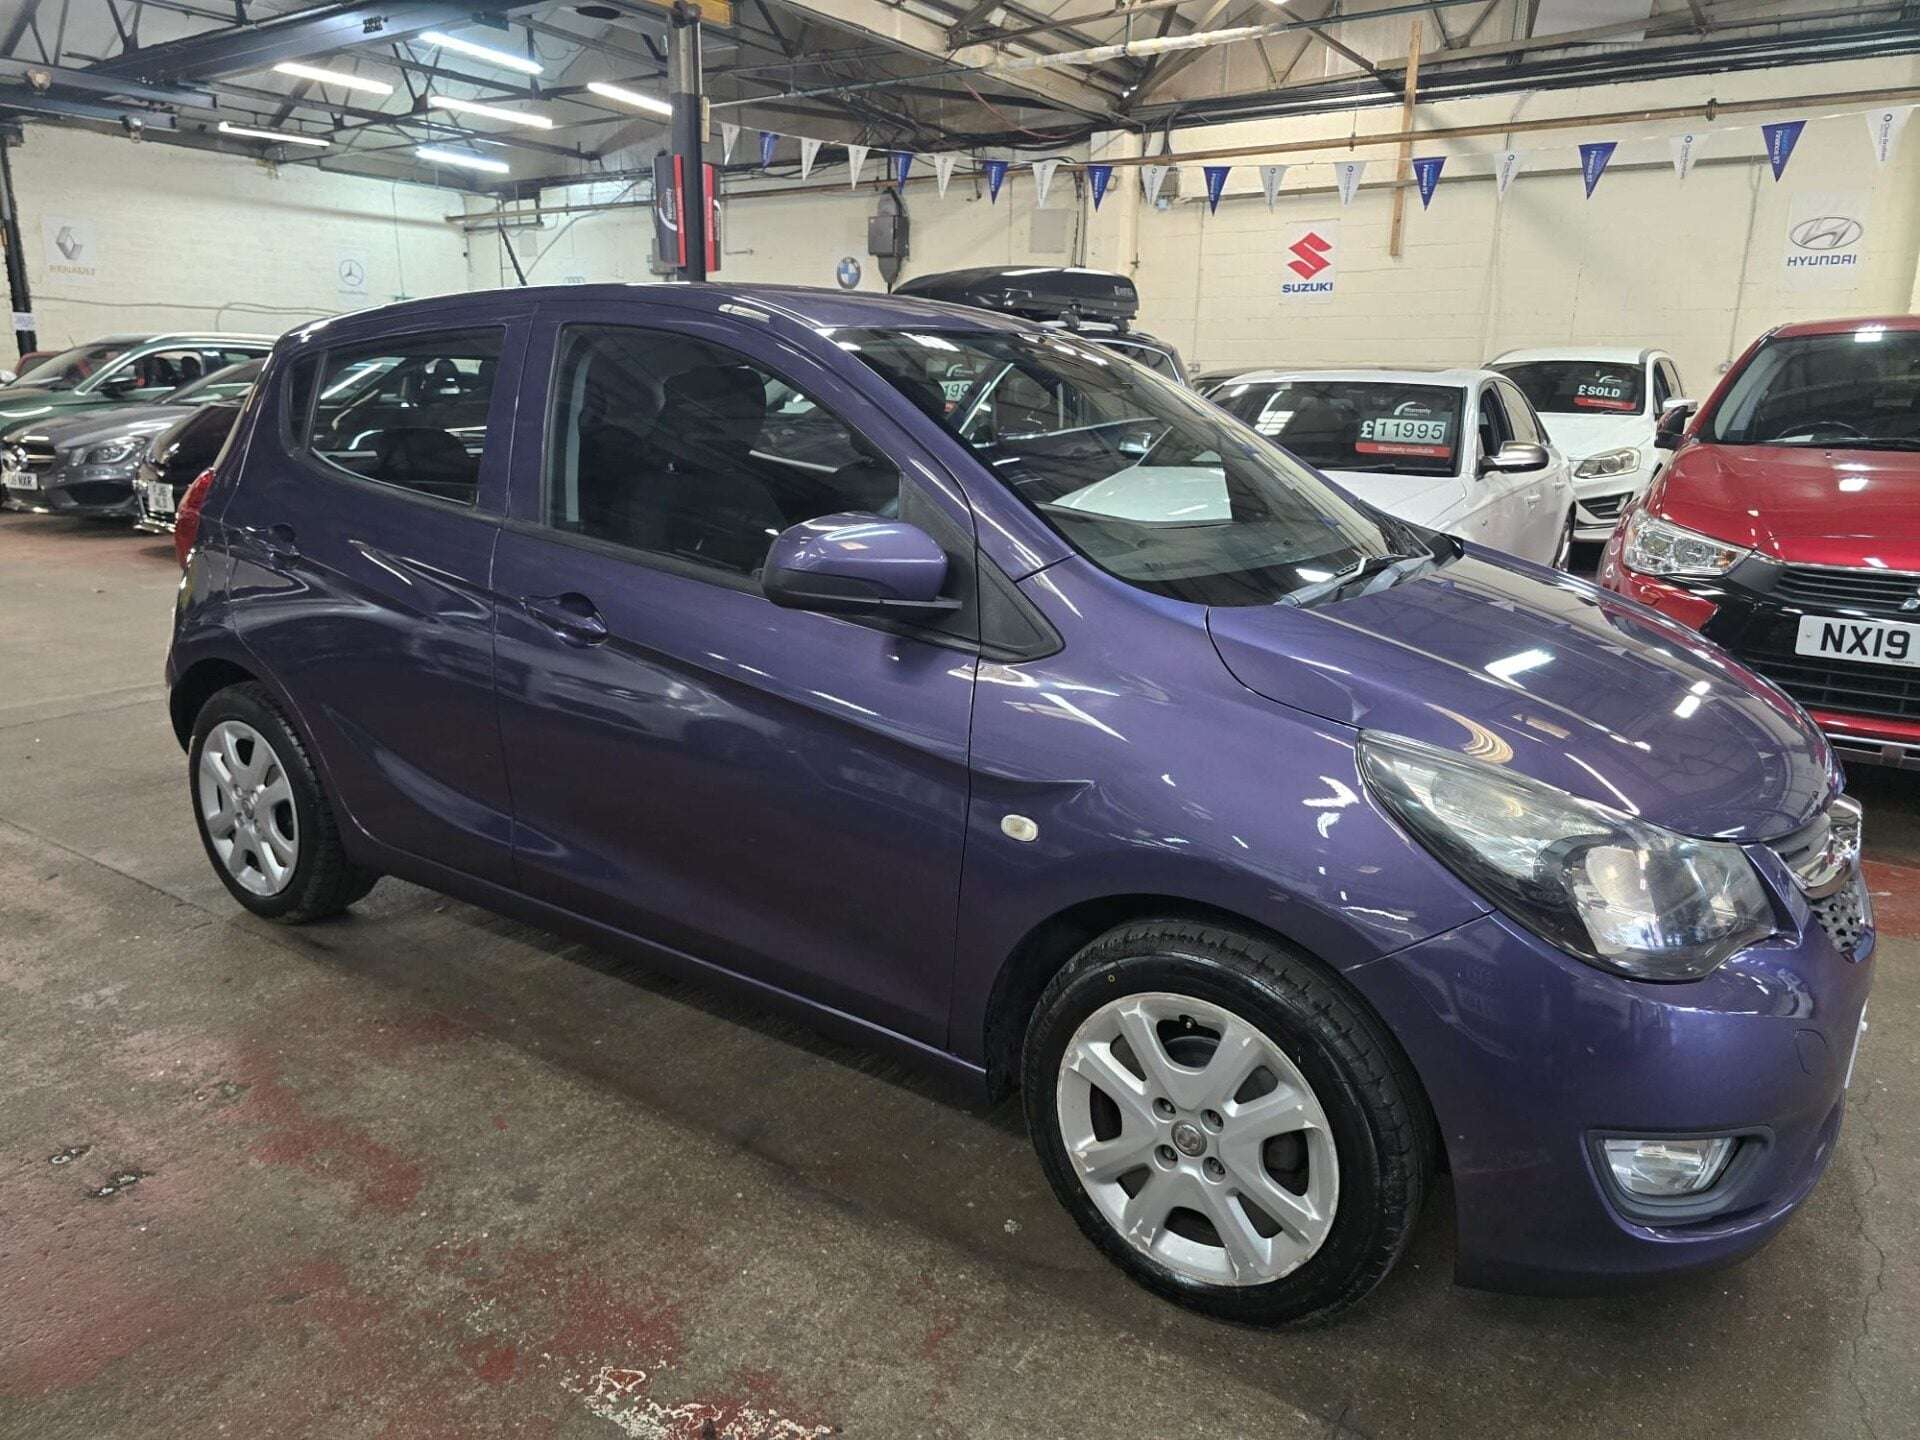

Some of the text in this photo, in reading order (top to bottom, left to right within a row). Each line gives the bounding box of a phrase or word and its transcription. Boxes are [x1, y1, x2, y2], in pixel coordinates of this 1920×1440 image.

[1787, 254, 1857, 267] HYUNDAI
[1282, 282, 1334, 293] SUZUKI
[1577, 384, 1621, 398] £SOLD
[1360, 420, 1444, 440] £11995
[1820, 623, 1911, 659] NX19
